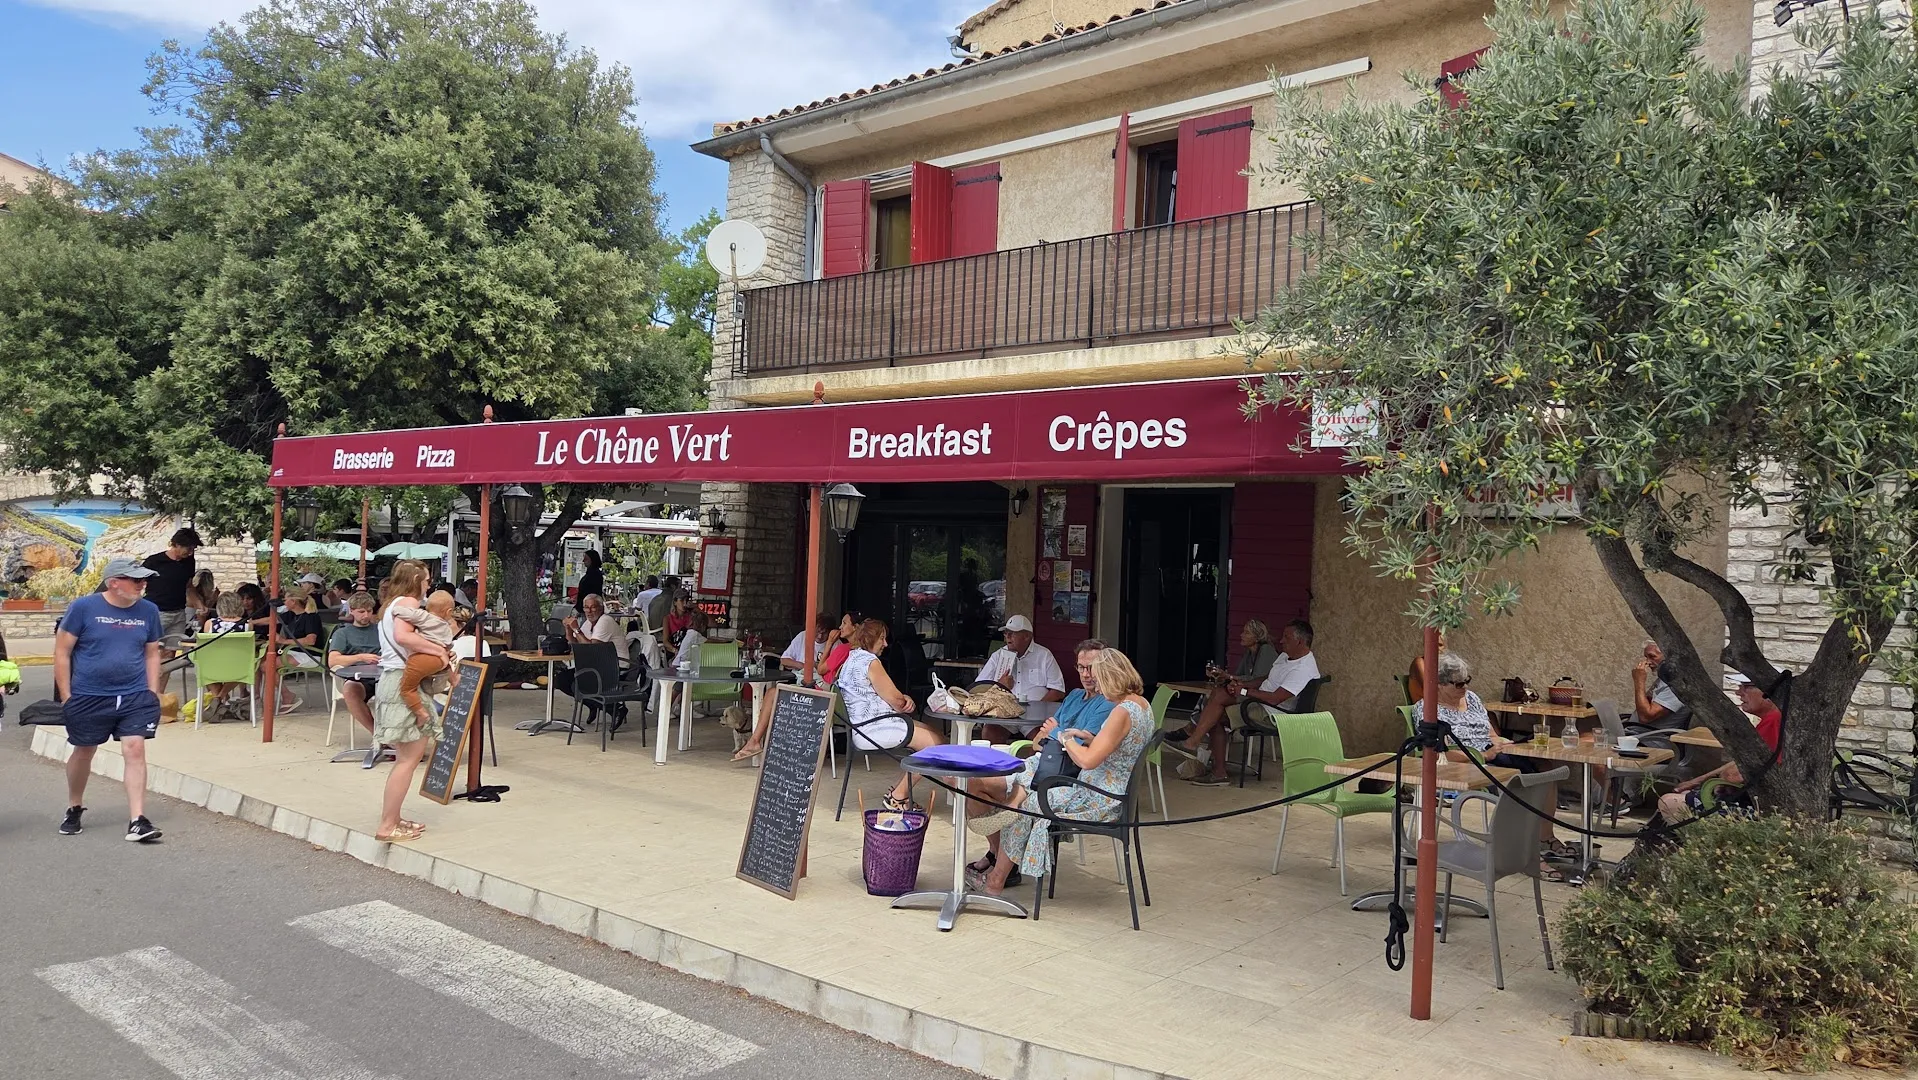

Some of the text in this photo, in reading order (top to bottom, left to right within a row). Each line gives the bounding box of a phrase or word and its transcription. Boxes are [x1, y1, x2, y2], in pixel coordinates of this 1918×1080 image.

[534, 423, 733, 465] Le Chêne Vert
[847, 422, 993, 459] Breakfast
[1048, 410, 1188, 460] Crêpes
[332, 446, 394, 470] Brasserie
[416, 444, 456, 468] Pizza
[698, 602, 727, 616] PIZZA
